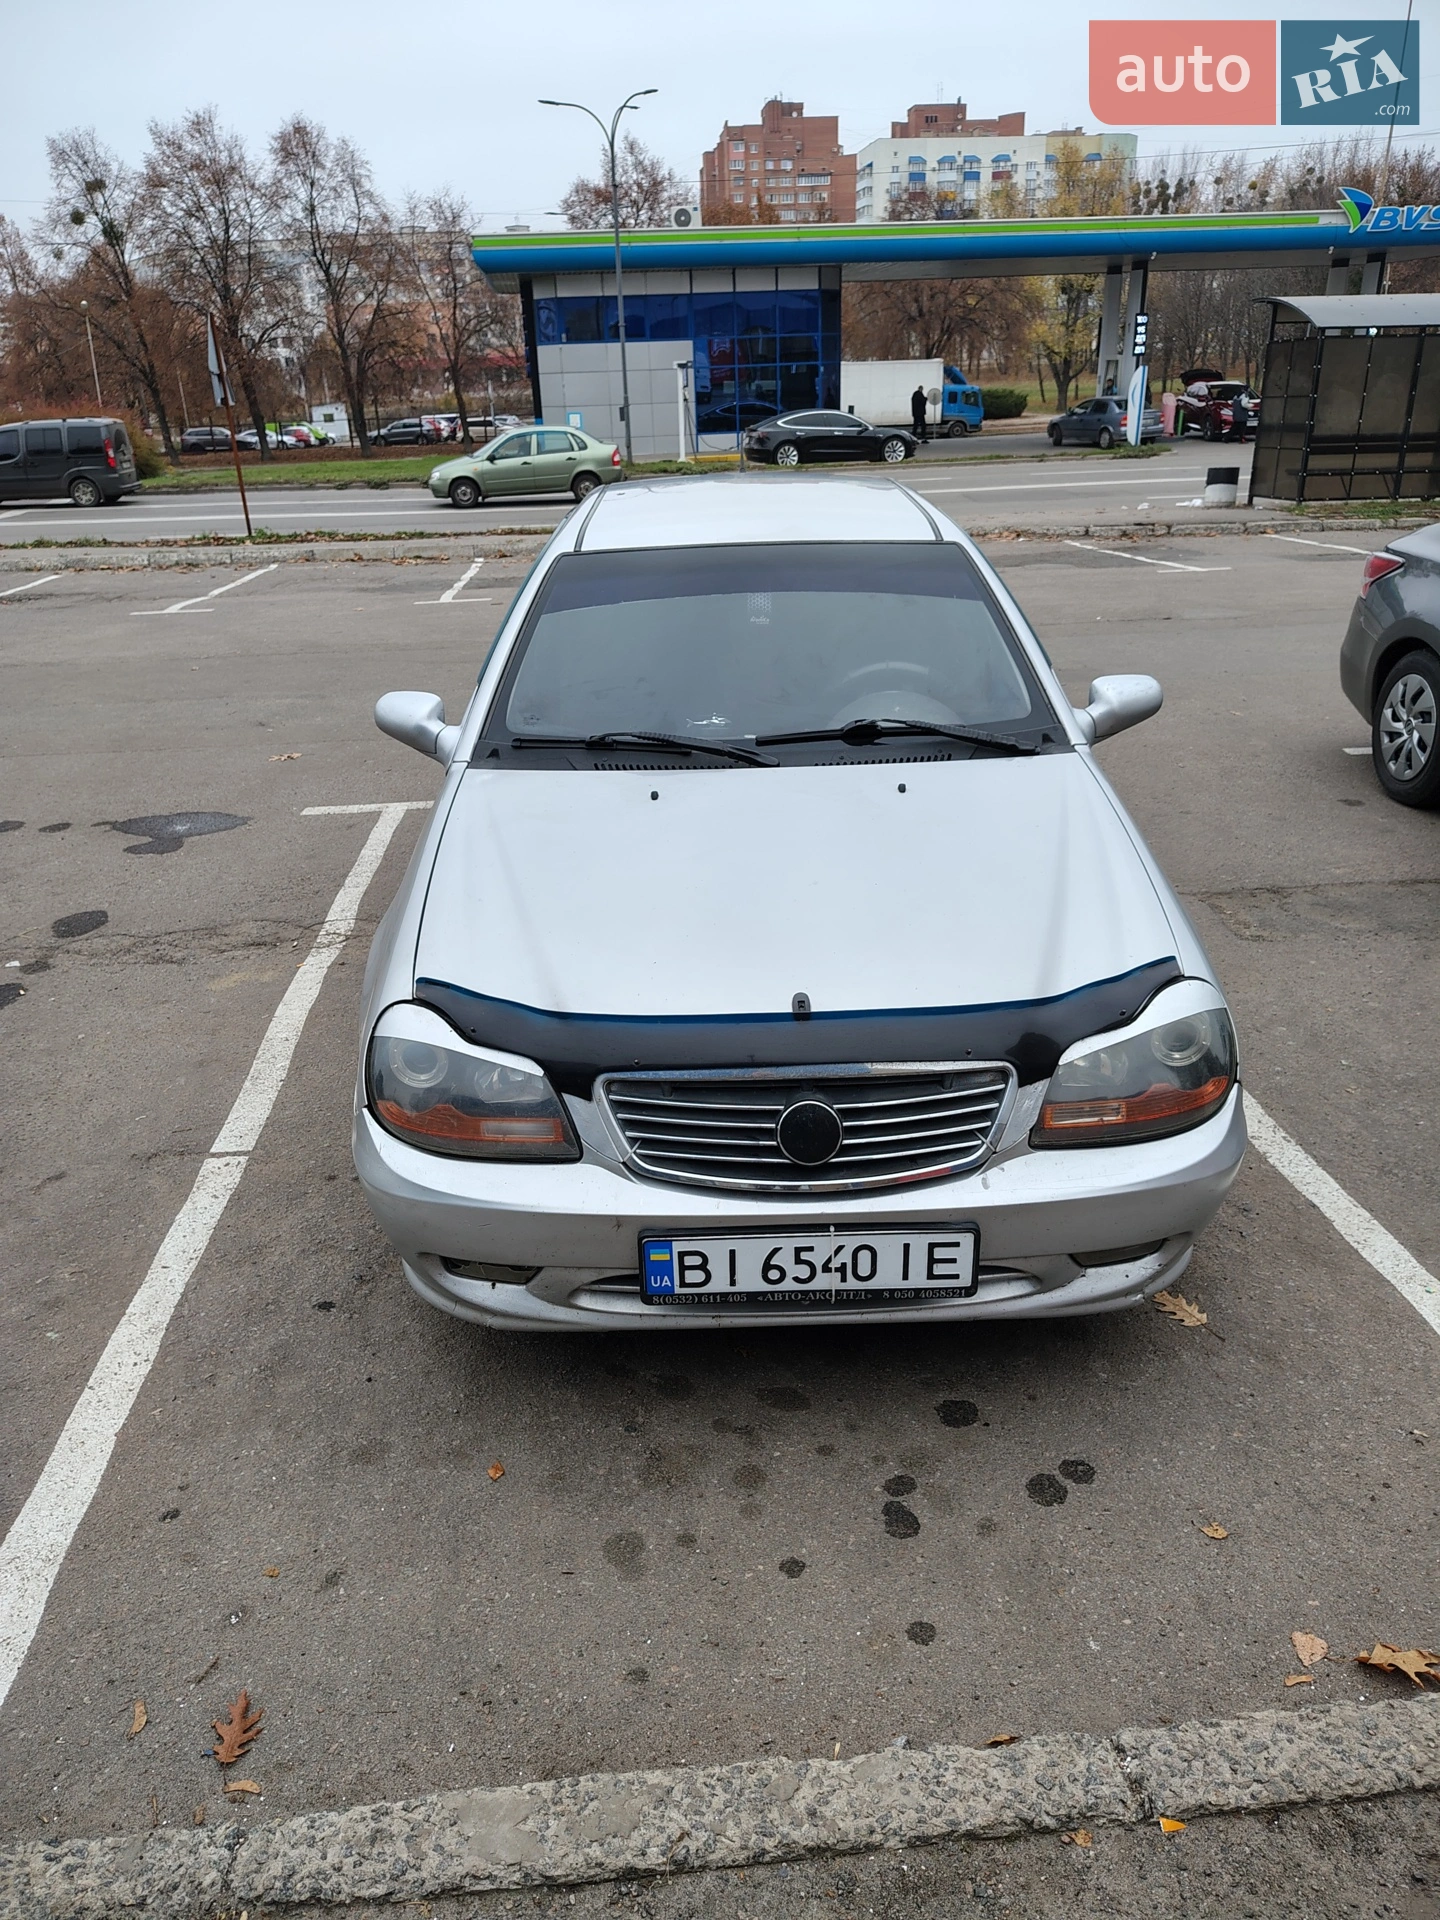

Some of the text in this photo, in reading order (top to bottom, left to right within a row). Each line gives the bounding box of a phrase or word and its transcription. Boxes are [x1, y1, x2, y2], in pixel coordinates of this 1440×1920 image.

[1366, 205, 1440, 232] BVS
[761, 1244, 878, 1286] 6540
[650, 1275, 672, 1287] UA
[701, 1292, 748, 1303] 611-405
[894, 1289, 915, 1299] 050
[919, 1288, 966, 1298] 4058521
